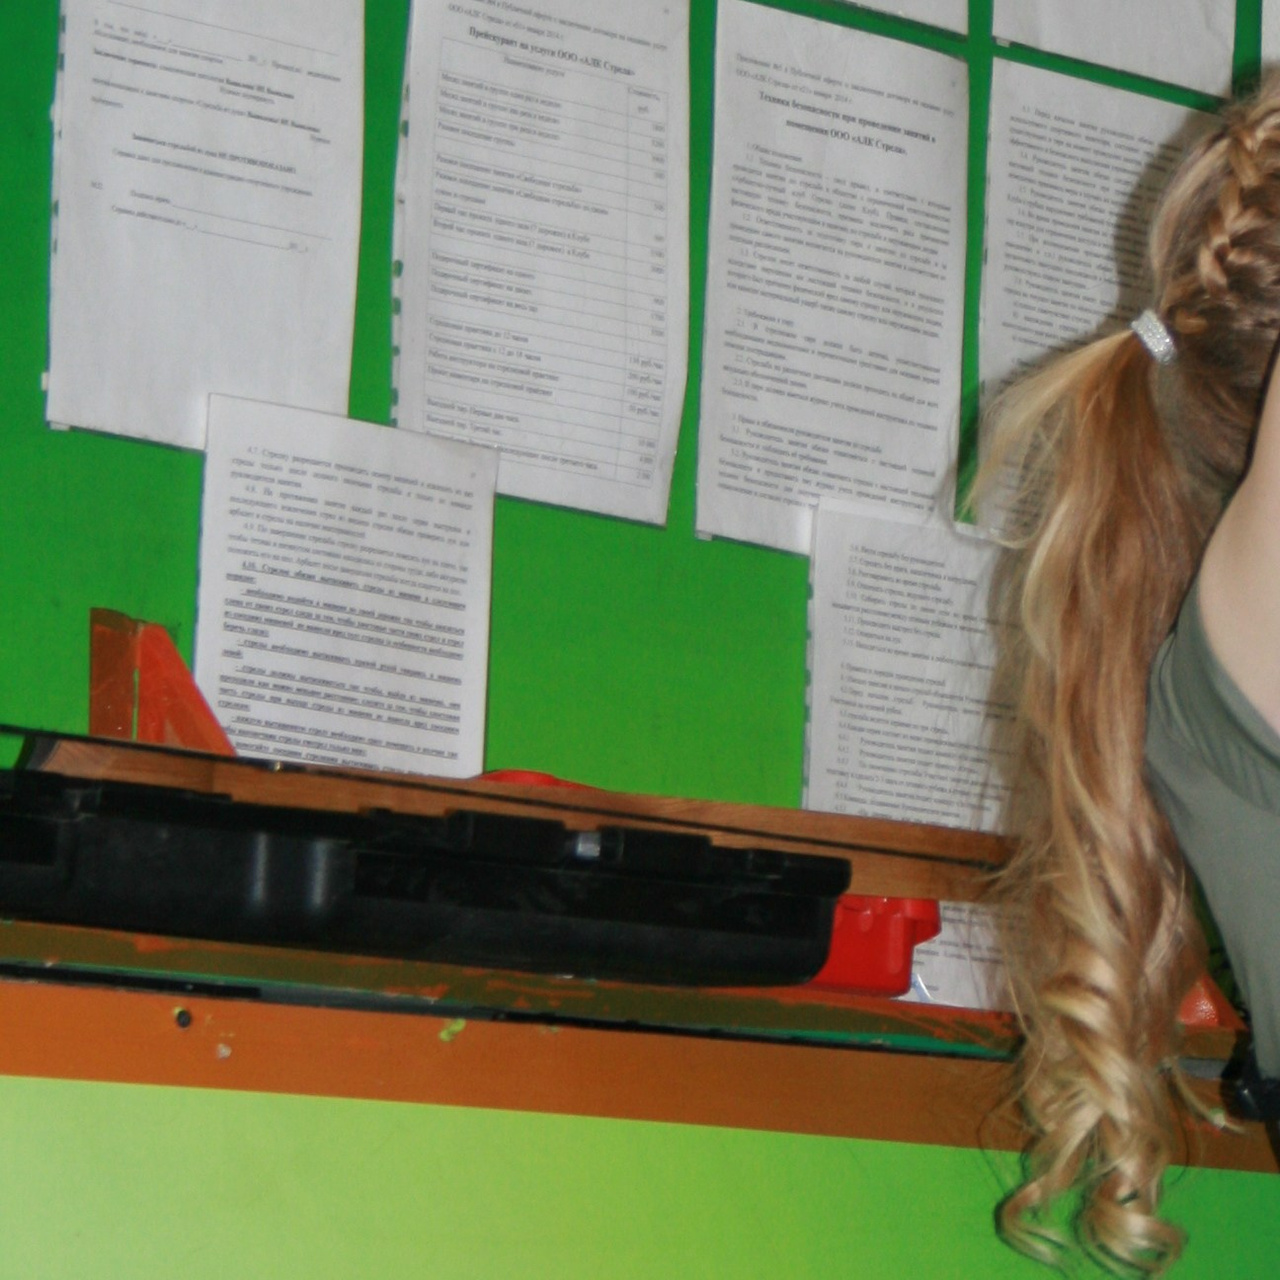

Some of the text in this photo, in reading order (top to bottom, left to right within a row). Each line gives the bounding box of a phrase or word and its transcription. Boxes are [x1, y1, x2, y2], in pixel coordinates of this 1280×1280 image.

[469, 26, 518, 47] Прейскурант
[530, 45, 556, 57] услуги
[557, 49, 578, 62] ООО
[759, 91, 790, 107] Техника
[791, 99, 840, 119] безопасности
[830, 128, 850, 140] ООО
